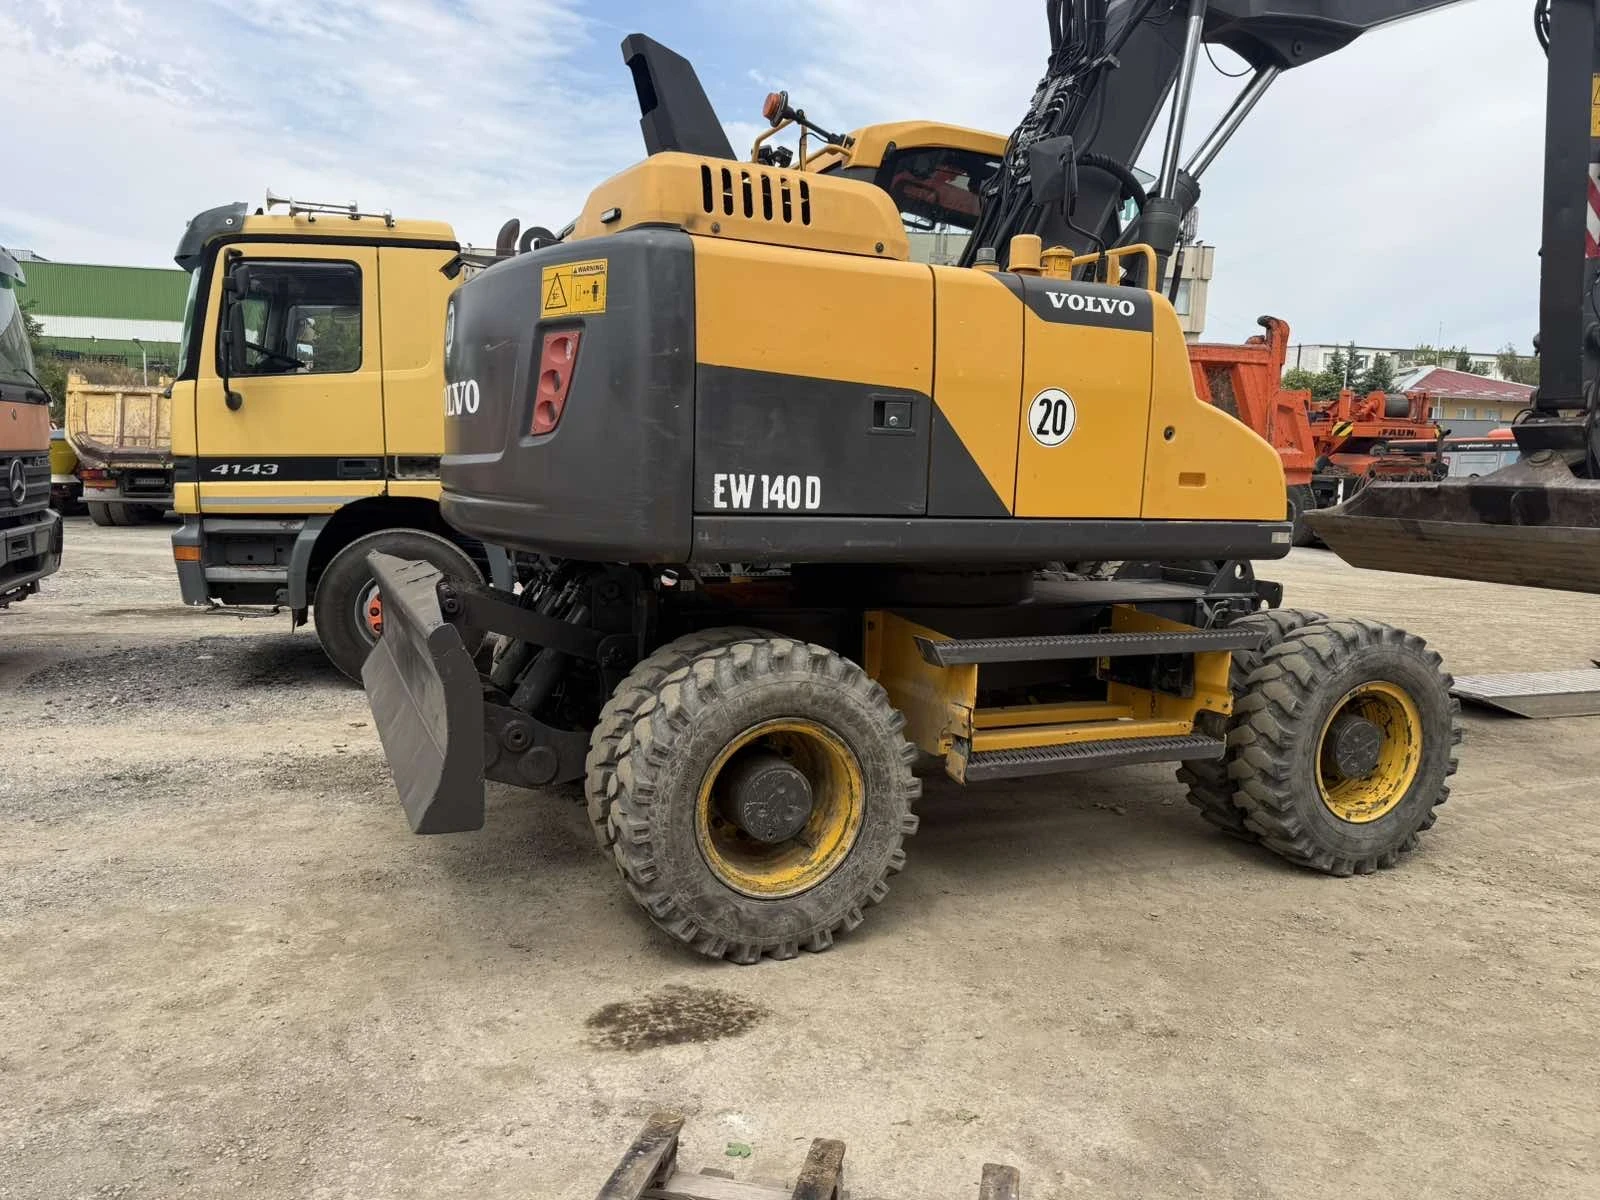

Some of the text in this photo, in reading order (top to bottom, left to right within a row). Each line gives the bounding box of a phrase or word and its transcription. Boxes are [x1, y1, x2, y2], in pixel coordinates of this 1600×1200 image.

[577, 264, 605, 273] WARNING
[1045, 291, 1136, 317] VOLVO
[1036, 398, 1067, 436] 20
[1382, 428, 1415, 437] FAUN
[210, 463, 279, 475] 4143
